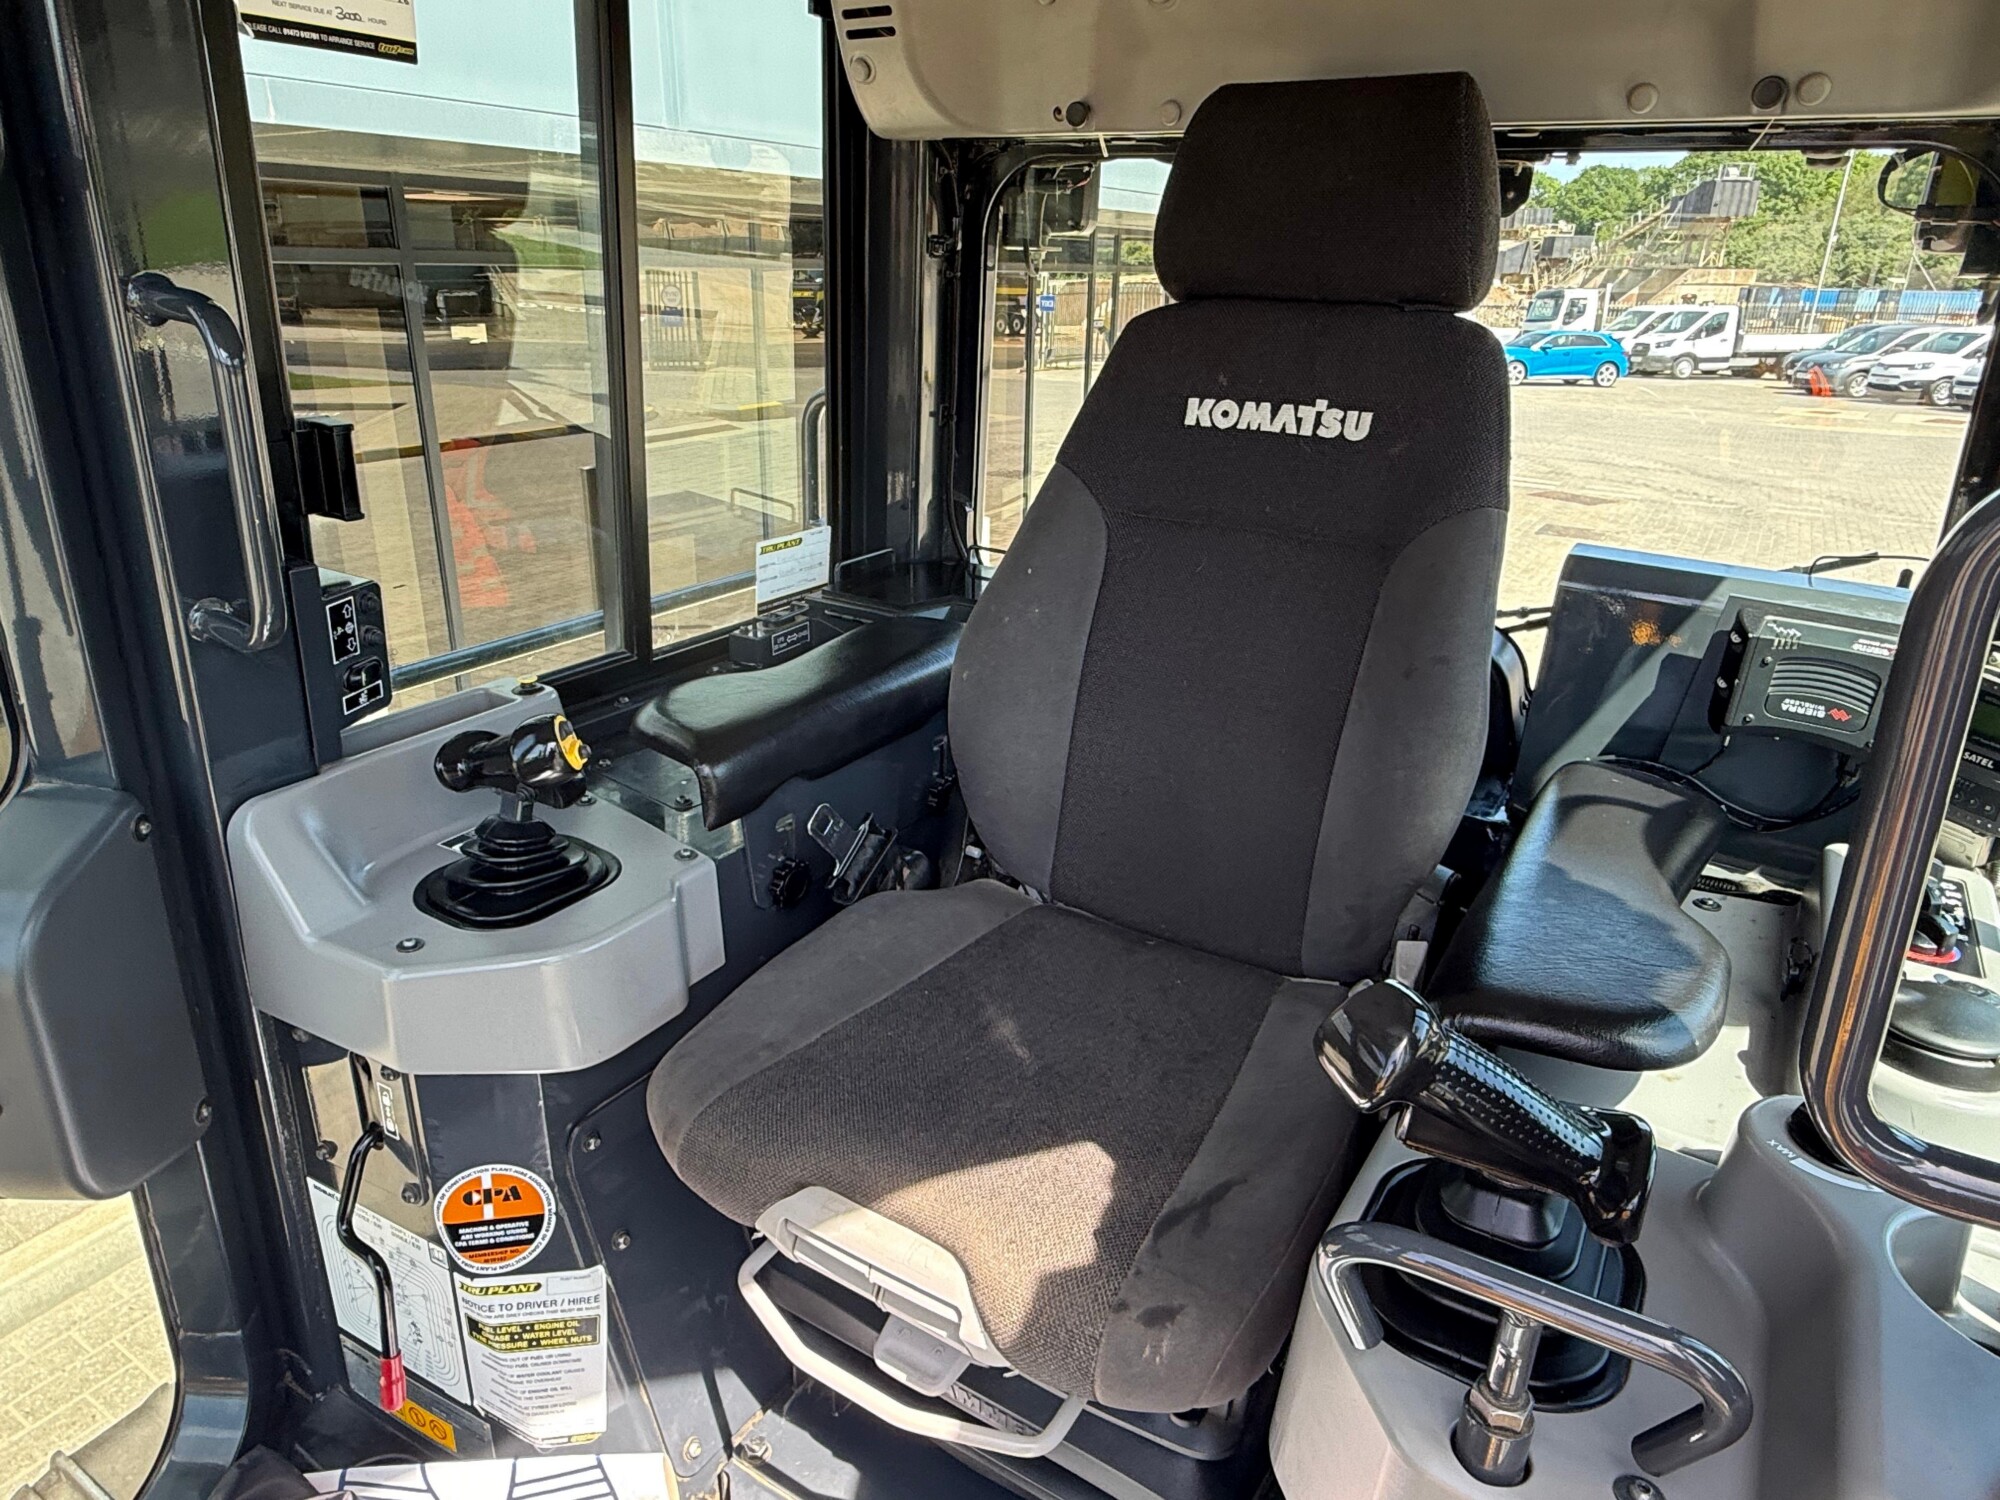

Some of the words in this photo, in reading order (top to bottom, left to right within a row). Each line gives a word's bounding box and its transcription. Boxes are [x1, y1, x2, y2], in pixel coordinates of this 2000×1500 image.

[288, 2, 312, 13] SERVICE
[313, 7, 325, 15] DUE
[367, 17, 387, 26] HOURS
[267, 25, 282, 35] CALL
[320, 33, 328, 42] TO
[328, 36, 354, 47] ARRANGE
[354, 39, 375, 50] SERVICE
[1184, 397, 1374, 442] KOMATSU
[1781, 703, 1826, 718] SIERRA
[1783, 698, 1825, 711] WIRELESS
[1963, 751, 1994, 769] SATEL
[1766, 1139, 1796, 1158] MAX
[462, 1185, 522, 1206] CPA
[445, 1168, 490, 1192] CONSTRUCTION
[499, 1241, 543, 1270] CONSTRUCTION
[458, 1225, 488, 1234] MACHINE
[495, 1221, 529, 1230] OPERATIVE
[474, 1230, 505, 1239] WORKING
[495, 1233, 535, 1243] CONDITIONS
[463, 1284, 486, 1295] TRU
[488, 1283, 538, 1295] PLANT
[462, 1297, 495, 1313] NOTICE
[498, 1303, 513, 1312] TO
[516, 1299, 558, 1311] DRIVER
[567, 1294, 600, 1306] HIREE
[478, 1322, 495, 1333] FUEL
[496, 1325, 523, 1334] LEVEL
[534, 1321, 566, 1330] ENGINE
[522, 1331, 551, 1340] WATER
[552, 1329, 578, 1337] LEVEL
[540, 1337, 569, 1346] WHEEL
[570, 1335, 593, 1343] NUTS
